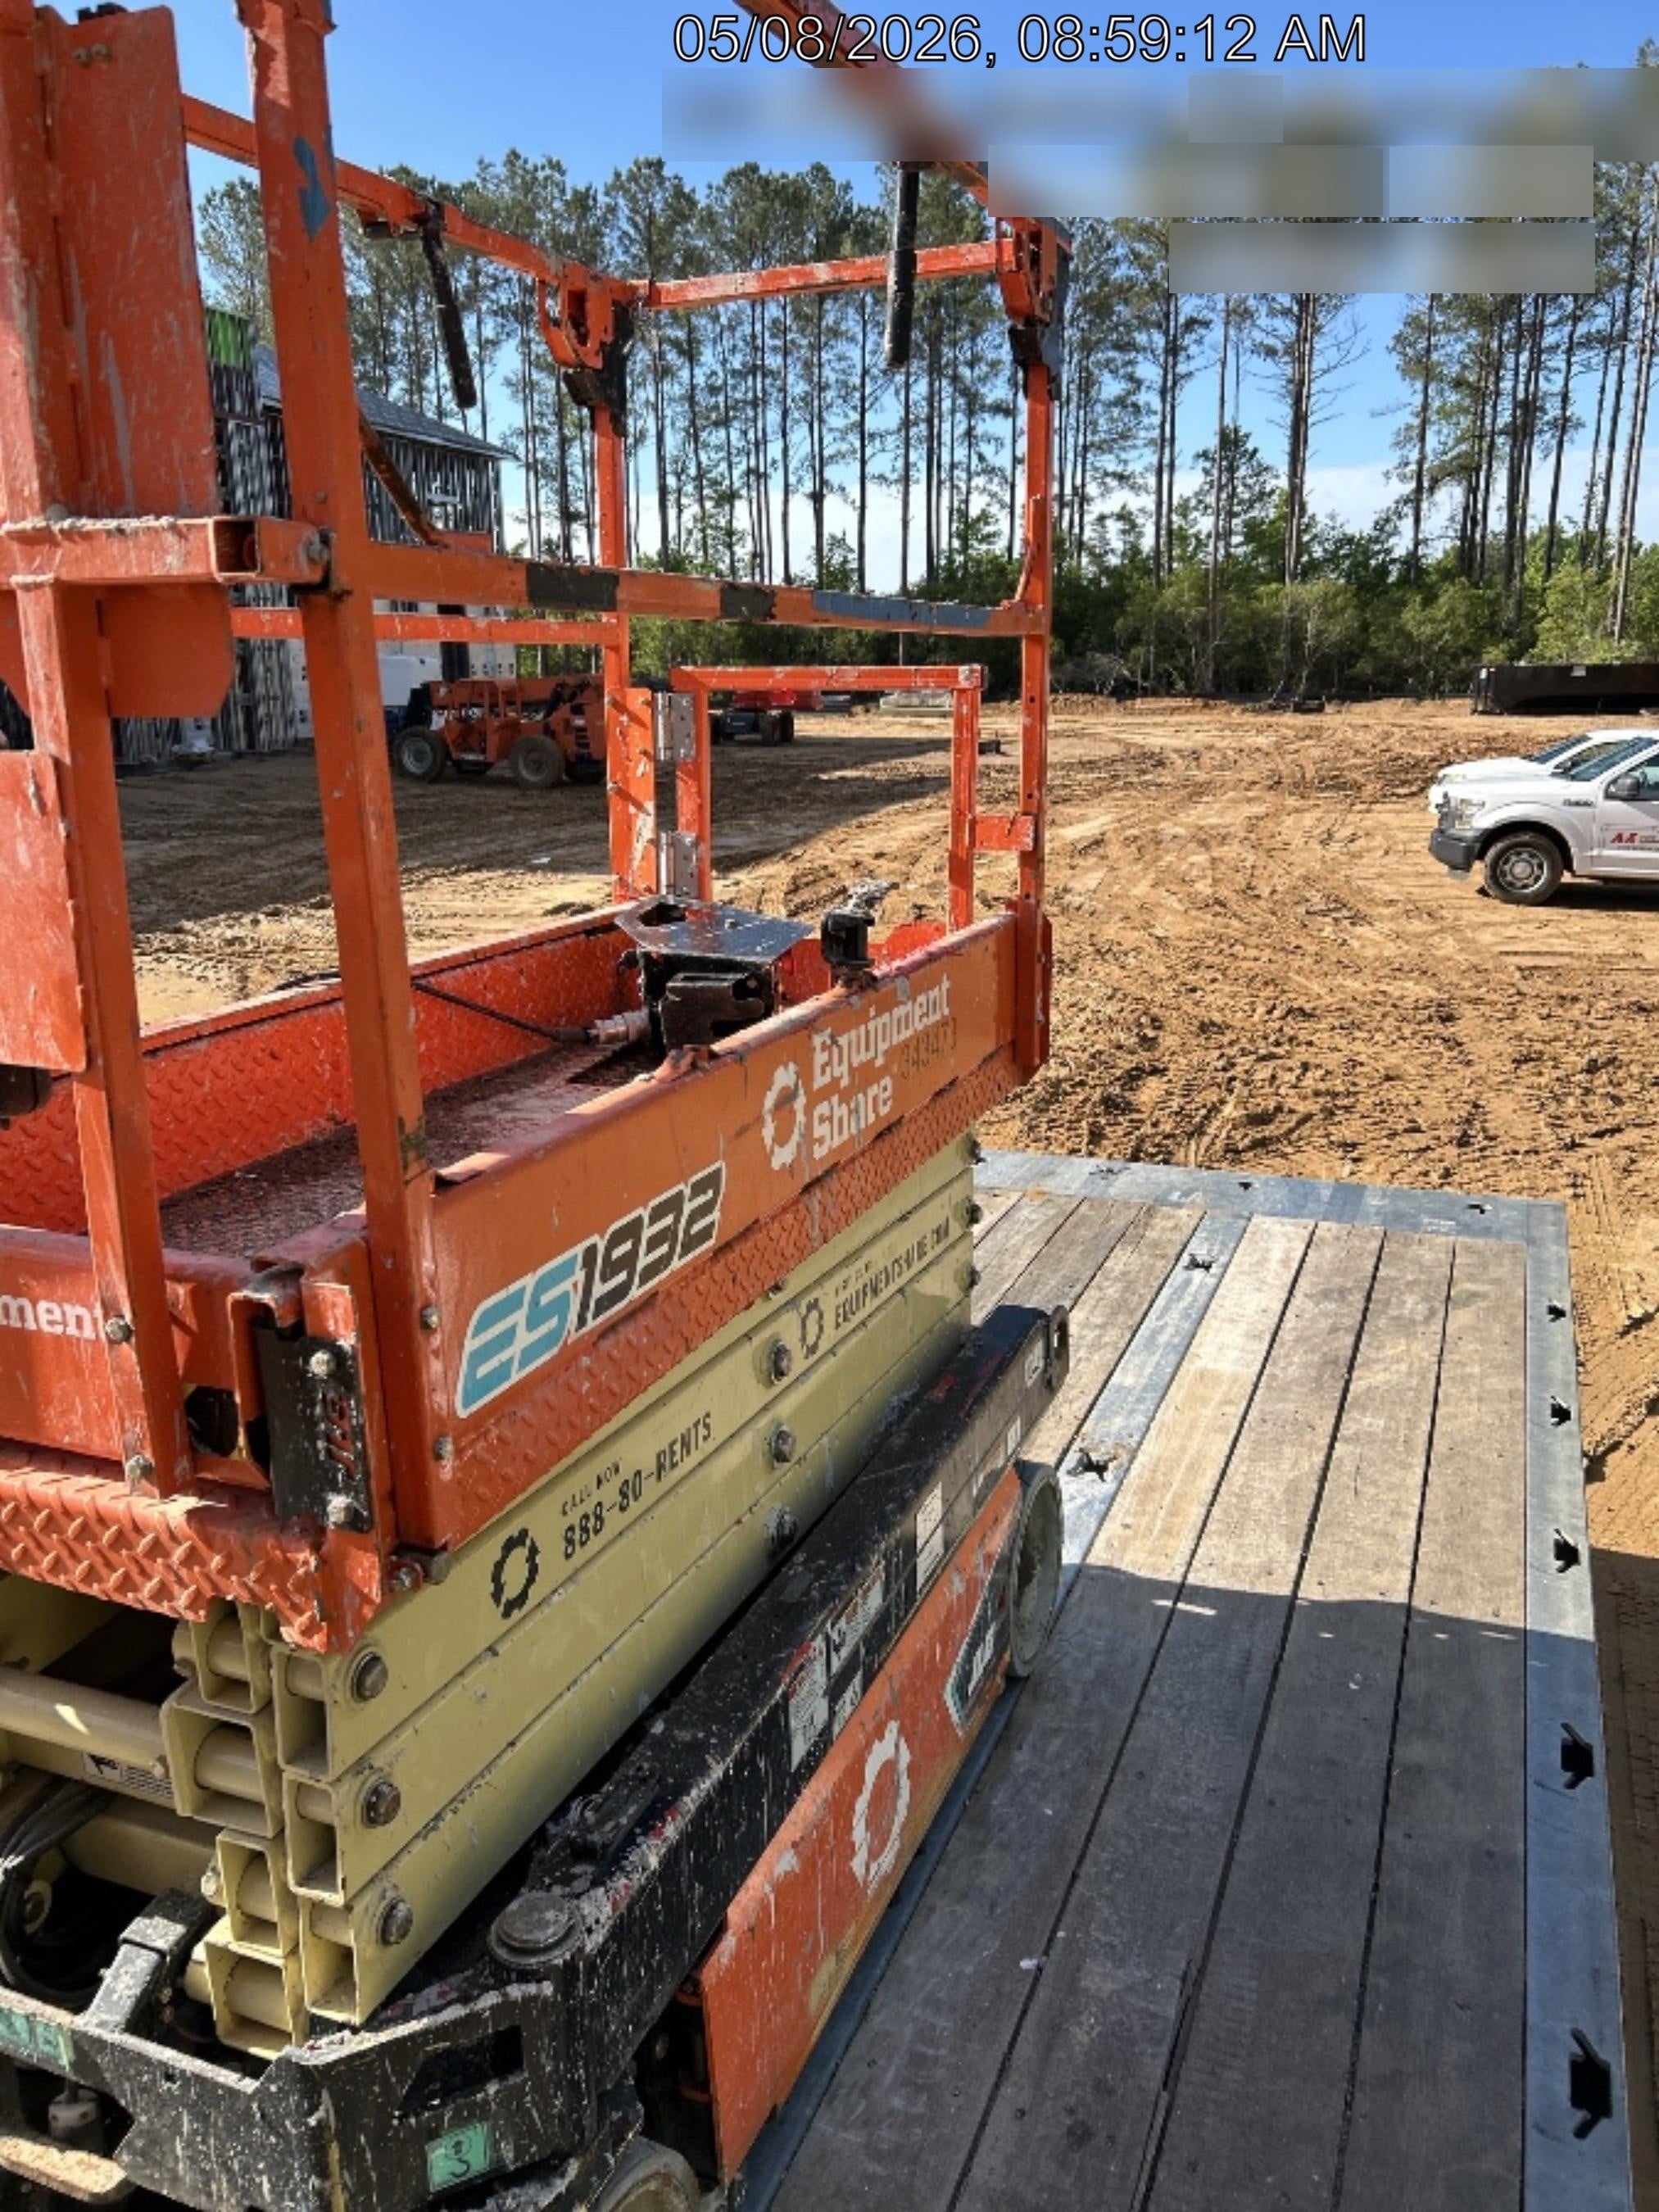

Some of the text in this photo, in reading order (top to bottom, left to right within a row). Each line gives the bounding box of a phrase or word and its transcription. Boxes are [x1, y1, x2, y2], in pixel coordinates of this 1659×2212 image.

[812, 973, 951, 1090] Equipment
[812, 1076, 893, 1160] Share
[456, 1160, 726, 1418] ES1932
[564, 1412, 712, 1561] 888-80-RENTS
